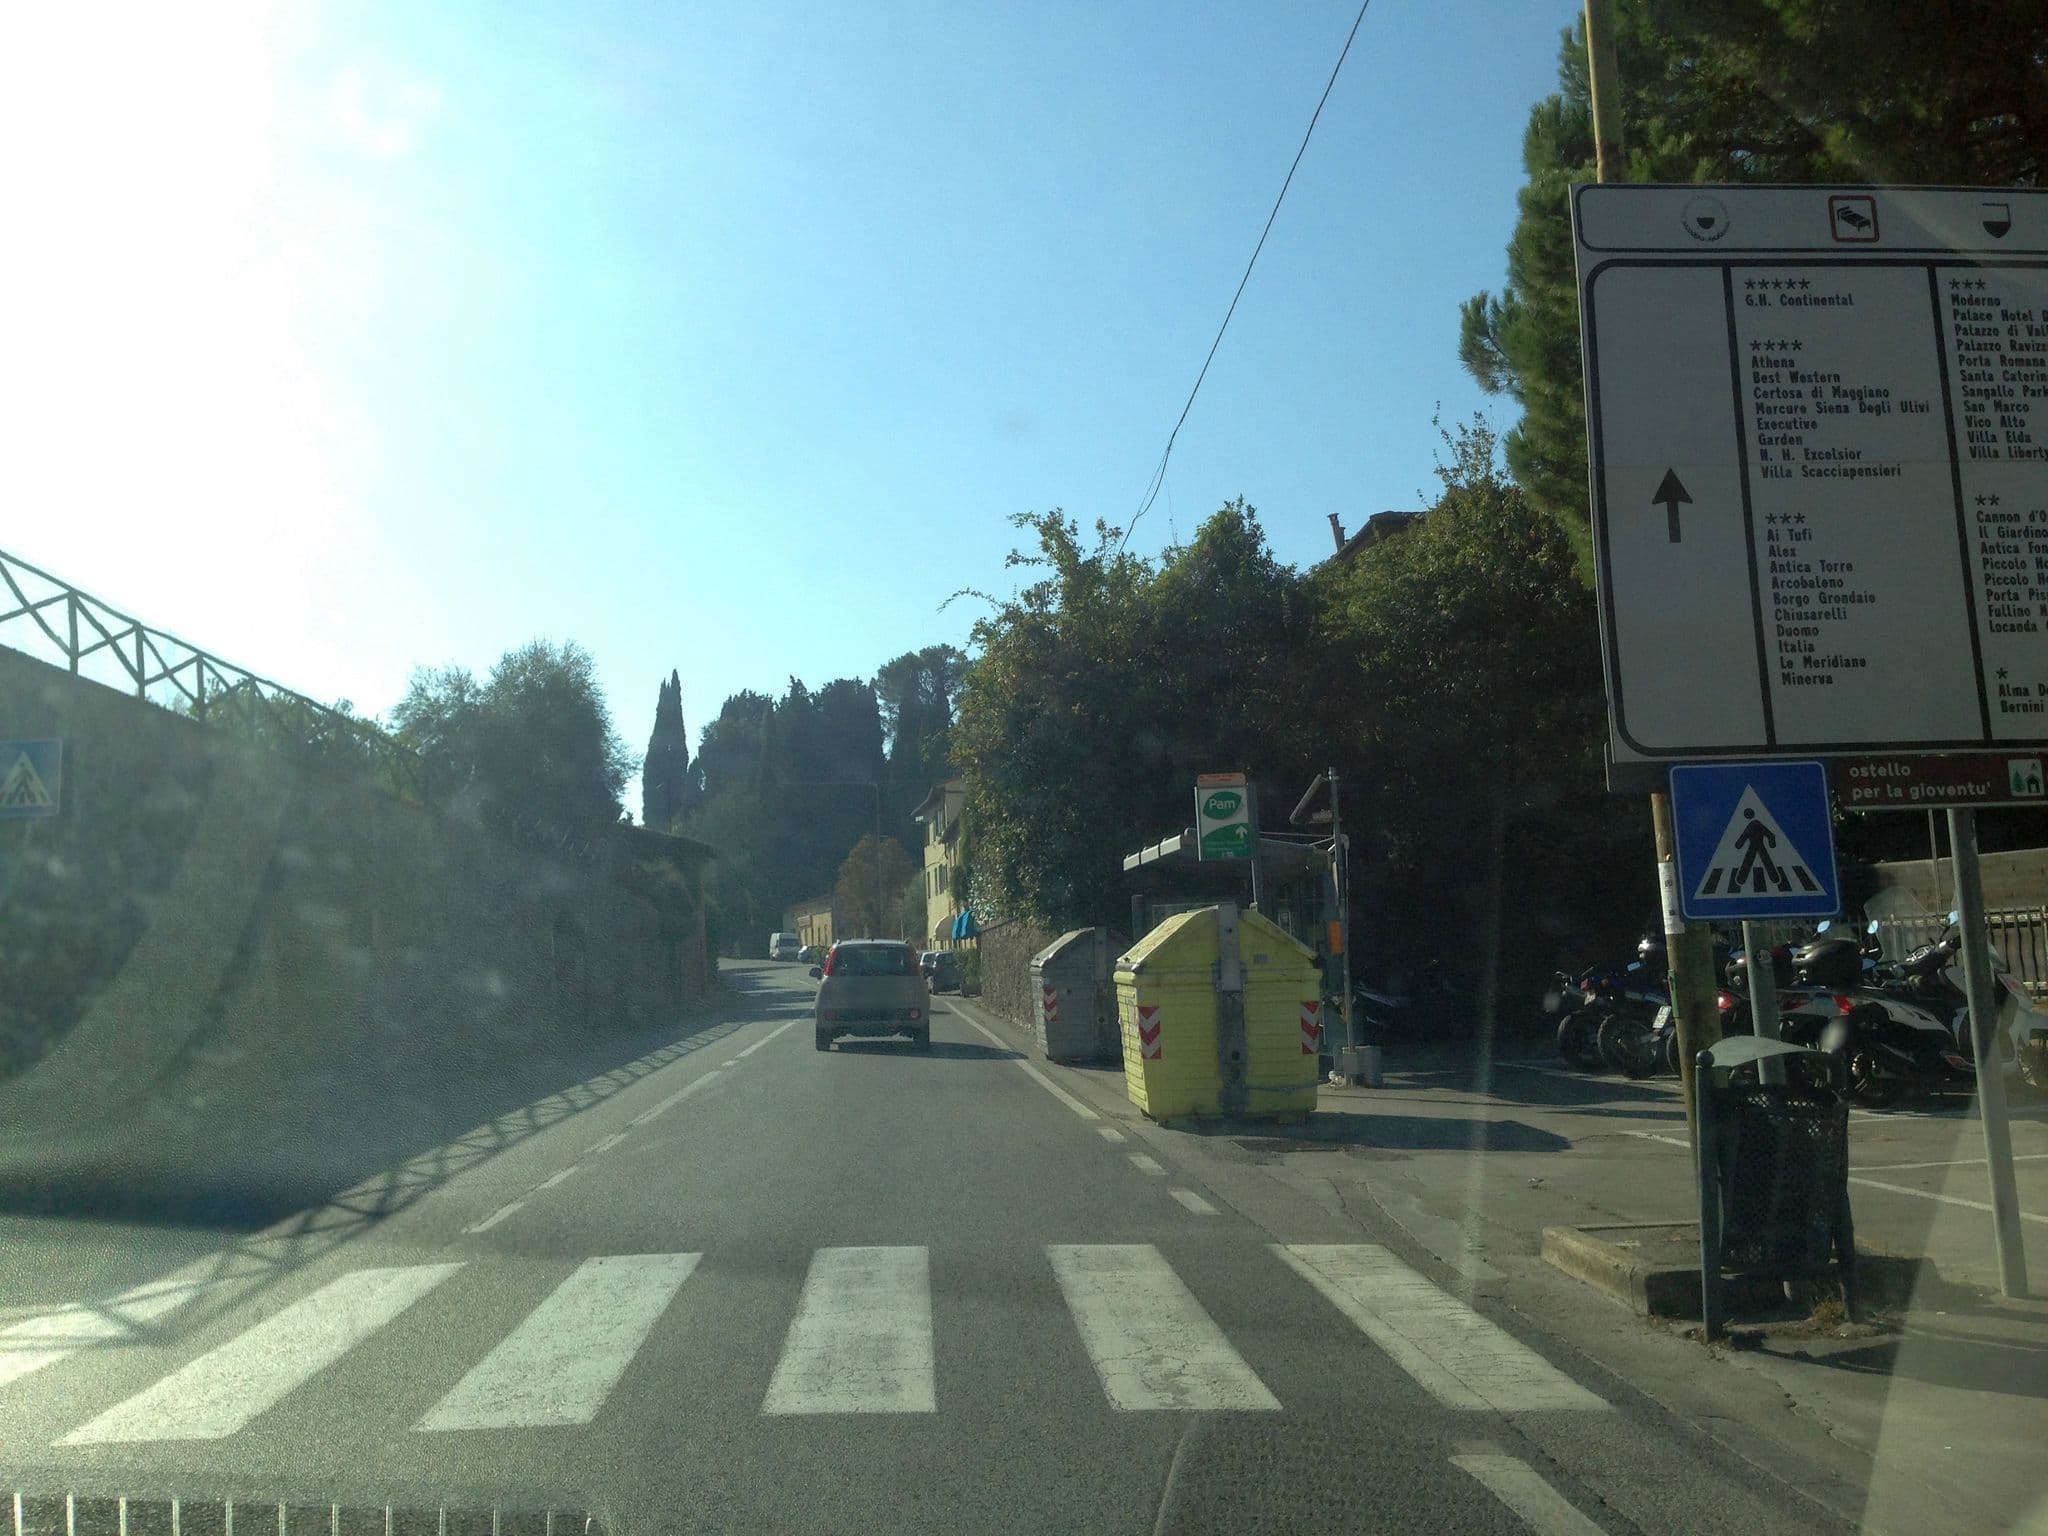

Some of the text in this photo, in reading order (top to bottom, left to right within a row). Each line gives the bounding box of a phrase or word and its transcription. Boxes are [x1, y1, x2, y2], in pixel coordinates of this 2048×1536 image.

[1780, 294, 1853, 306] Continental
[1951, 294, 2000, 306] Moderno
[1953, 308, 1992, 321] Palace
[2001, 309, 2033, 321] Hotel
[1955, 324, 1999, 336] Palazzo
[2008, 325, 2018, 336] di
[1957, 339, 2001, 351] Palazzo
[1752, 356, 1794, 368] Athena
[1959, 354, 2046, 367] Porta Romana
[1753, 371, 1840, 383] Best Western
[1960, 369, 2048, 381] Santa Caterin
[1754, 386, 1889, 401] Certosa di Maggiano
[1962, 385, 2048, 400] Sangallo Park
[1756, 401, 1930, 416] Mercure Siena Degli Ulivi
[1964, 400, 2029, 412] San Marco
[1757, 418, 1817, 430] Executive
[1966, 415, 2025, 427] Vico Alto
[1759, 434, 1802, 445] Garden
[1968, 431, 2031, 443] Villa Elda
[1783, 449, 1795, 461] H.
[1805, 448, 1862, 460] Excelsior
[1969, 446, 2000, 458] Villa
[1761, 464, 1901, 480] Villa Scacciapensieri
[1976, 510, 2020, 523] Cannon
[1767, 528, 1812, 541] Ai Tufi
[1979, 526, 2048, 538] Il Giardino
[1768, 545, 1796, 557] Alex
[1981, 541, 2020, 554] Antica
[1770, 560, 1853, 573] Antica Torre
[1983, 557, 2027, 570] Piccolo
[1772, 576, 1843, 589] Arcobaleno
[1984, 573, 2029, 585] Piccolo
[1773, 592, 1809, 607] Borgo
[1986, 589, 2020, 601] Porta
[1775, 607, 1847, 621] Chiusarelli
[1777, 624, 1819, 636] Duomo
[1989, 620, 2038, 633] Locanda
[1779, 640, 1814, 653] Italia
[1780, 655, 1866, 669] Le Meridiane
[1782, 672, 1833, 685] Minerva
[1999, 683, 2048, 696] Alma D
[2000, 700, 2044, 713] Bernini
[1849, 763, 1911, 777] ostello
[1852, 786, 1880, 800] per
[1887, 784, 1903, 797] la
[1209, 799, 1235, 809] Pam
